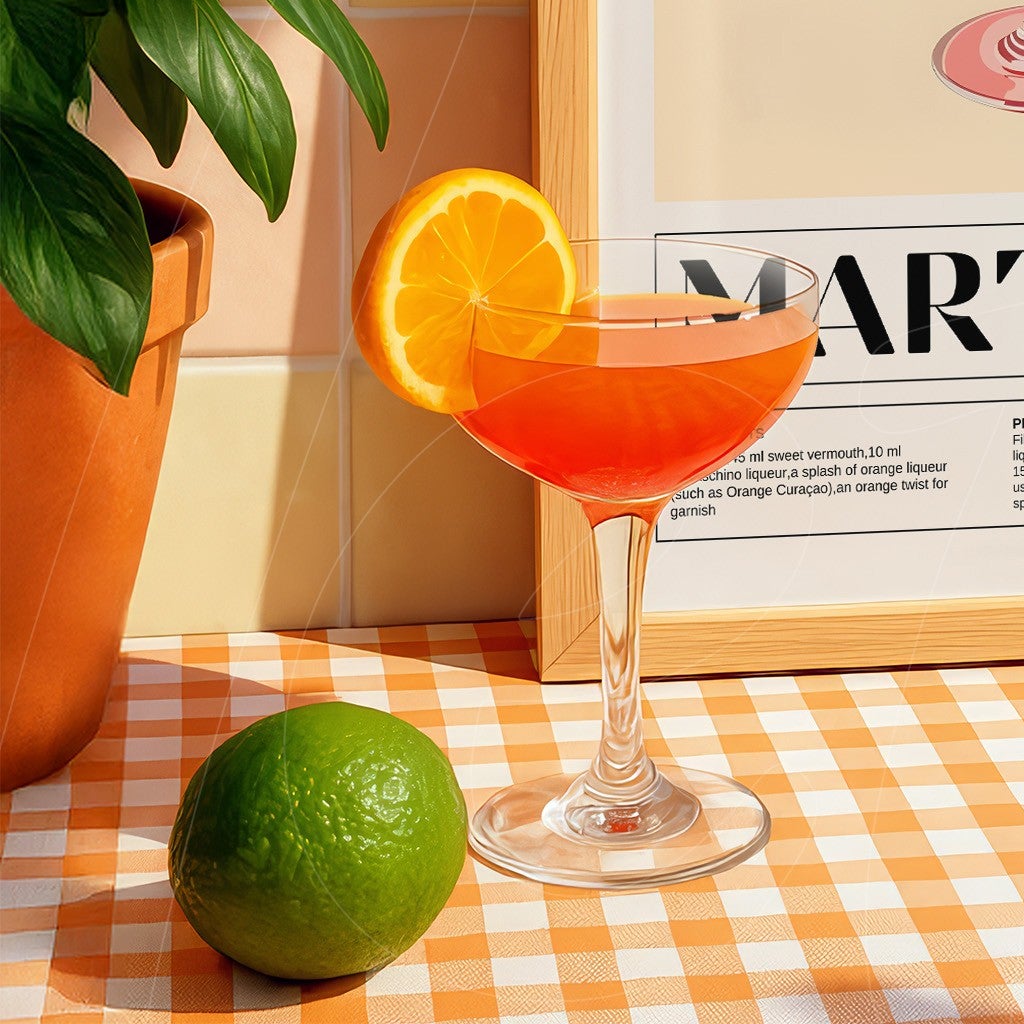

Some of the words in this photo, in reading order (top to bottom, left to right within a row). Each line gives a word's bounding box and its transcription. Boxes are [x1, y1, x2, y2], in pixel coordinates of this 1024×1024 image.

[749, 450, 764, 463] ml
[767, 450, 805, 463] sweet
[806, 445, 884, 461] vermouth,10
[887, 444, 901, 458] ml
[745, 467, 799, 483] liqueur,a
[801, 464, 842, 481] splash
[845, 463, 858, 476] of
[860, 464, 903, 478] orange
[906, 461, 948, 476] liqueur
[707, 488, 724, 499] as
[726, 485, 773, 500] Orange
[776, 481, 852, 498] Curaçao),an
[855, 481, 898, 495] orange
[901, 477, 930, 491] twist
[932, 477, 949, 490] for
[670, 503, 716, 521] garnish
